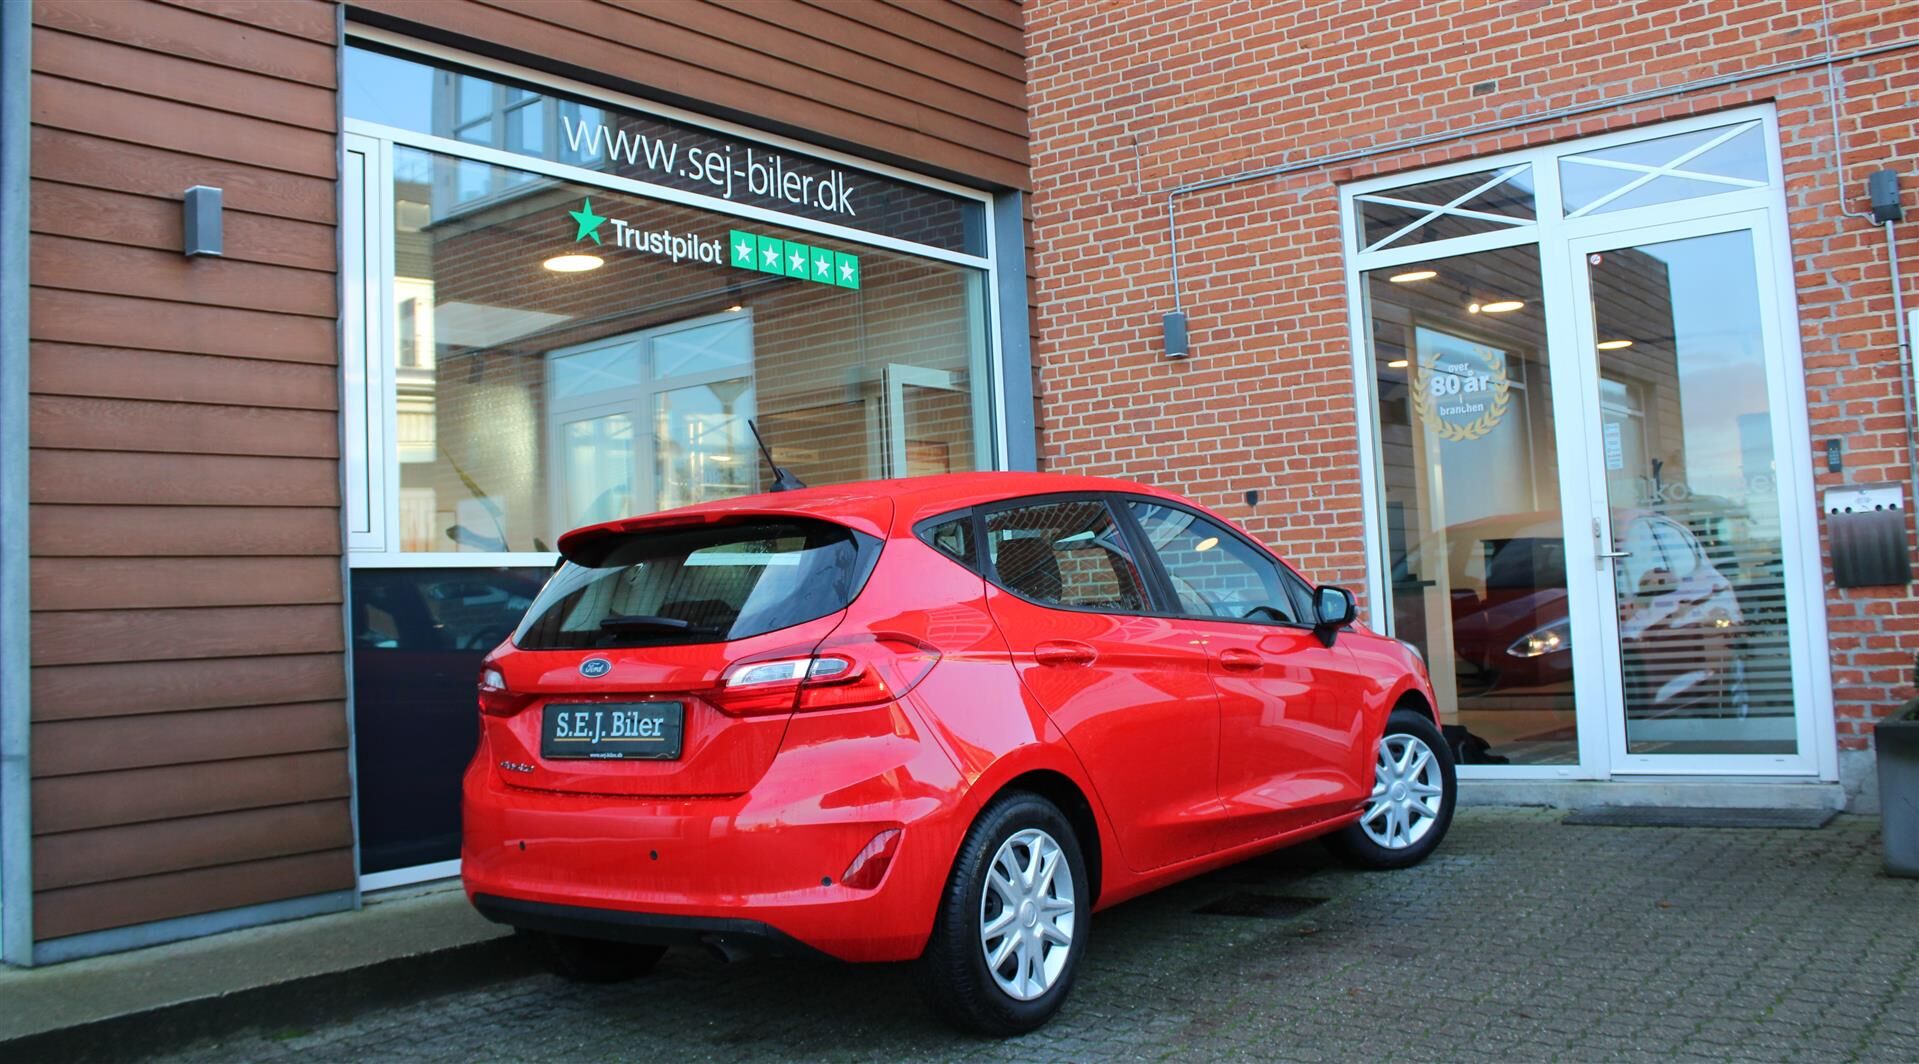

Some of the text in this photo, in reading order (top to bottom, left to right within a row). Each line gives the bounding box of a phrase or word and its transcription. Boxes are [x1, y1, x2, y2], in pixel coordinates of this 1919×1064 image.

[563, 115, 856, 216] www.sej-biler.dk
[610, 218, 722, 265] Trustpilot
[1448, 362, 1469, 373] over
[1431, 370, 1489, 397] 80 år
[1440, 403, 1484, 416] branchen
[585, 662, 604, 673] Ford
[556, 712, 664, 743] S.E.J. Biler
